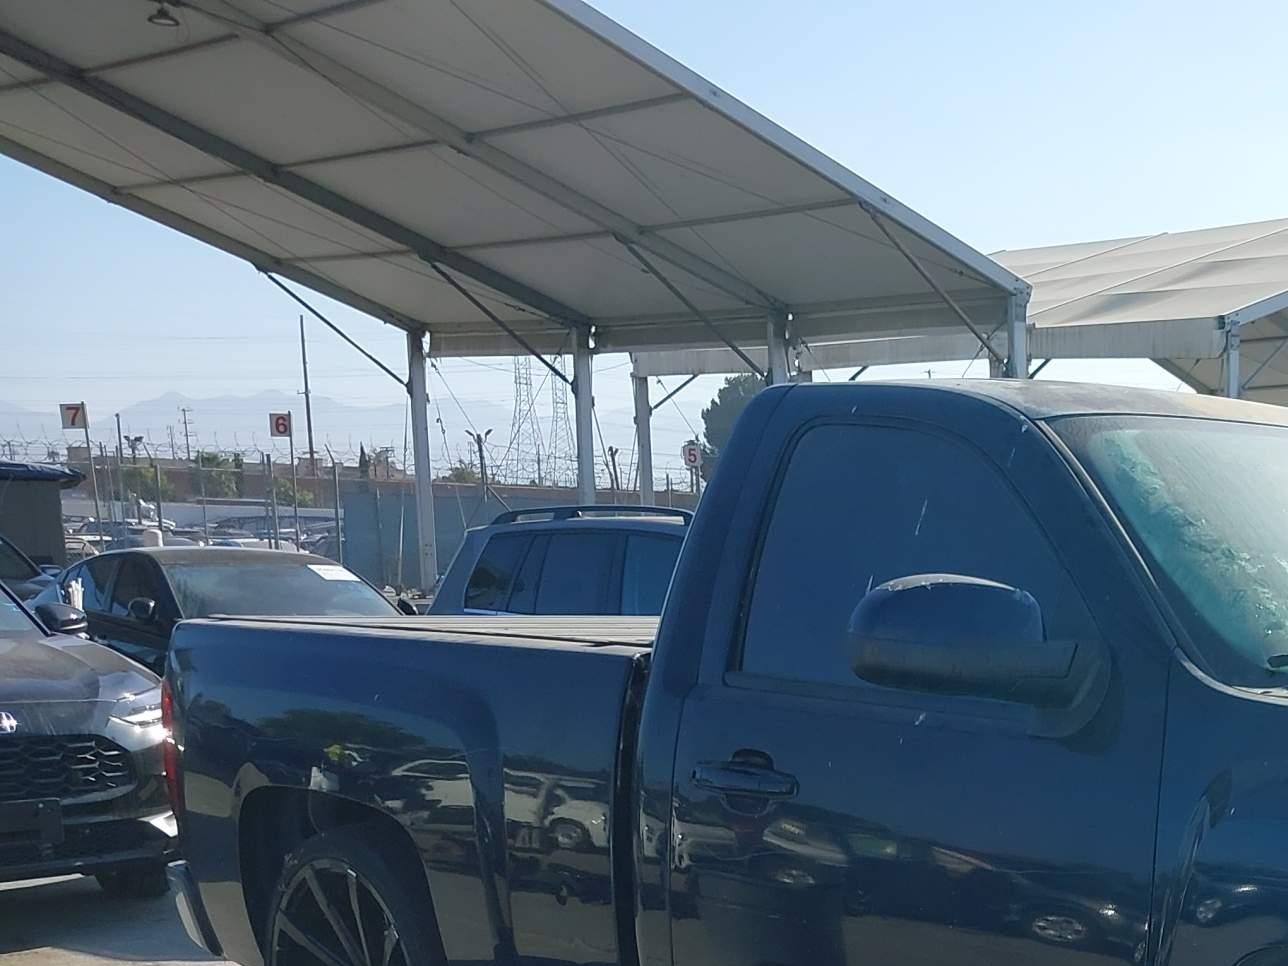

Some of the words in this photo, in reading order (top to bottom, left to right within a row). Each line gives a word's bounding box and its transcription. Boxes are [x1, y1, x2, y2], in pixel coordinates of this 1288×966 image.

[65, 406, 81, 426] 7
[275, 415, 288, 434] 6
[687, 447, 697, 464] 5
